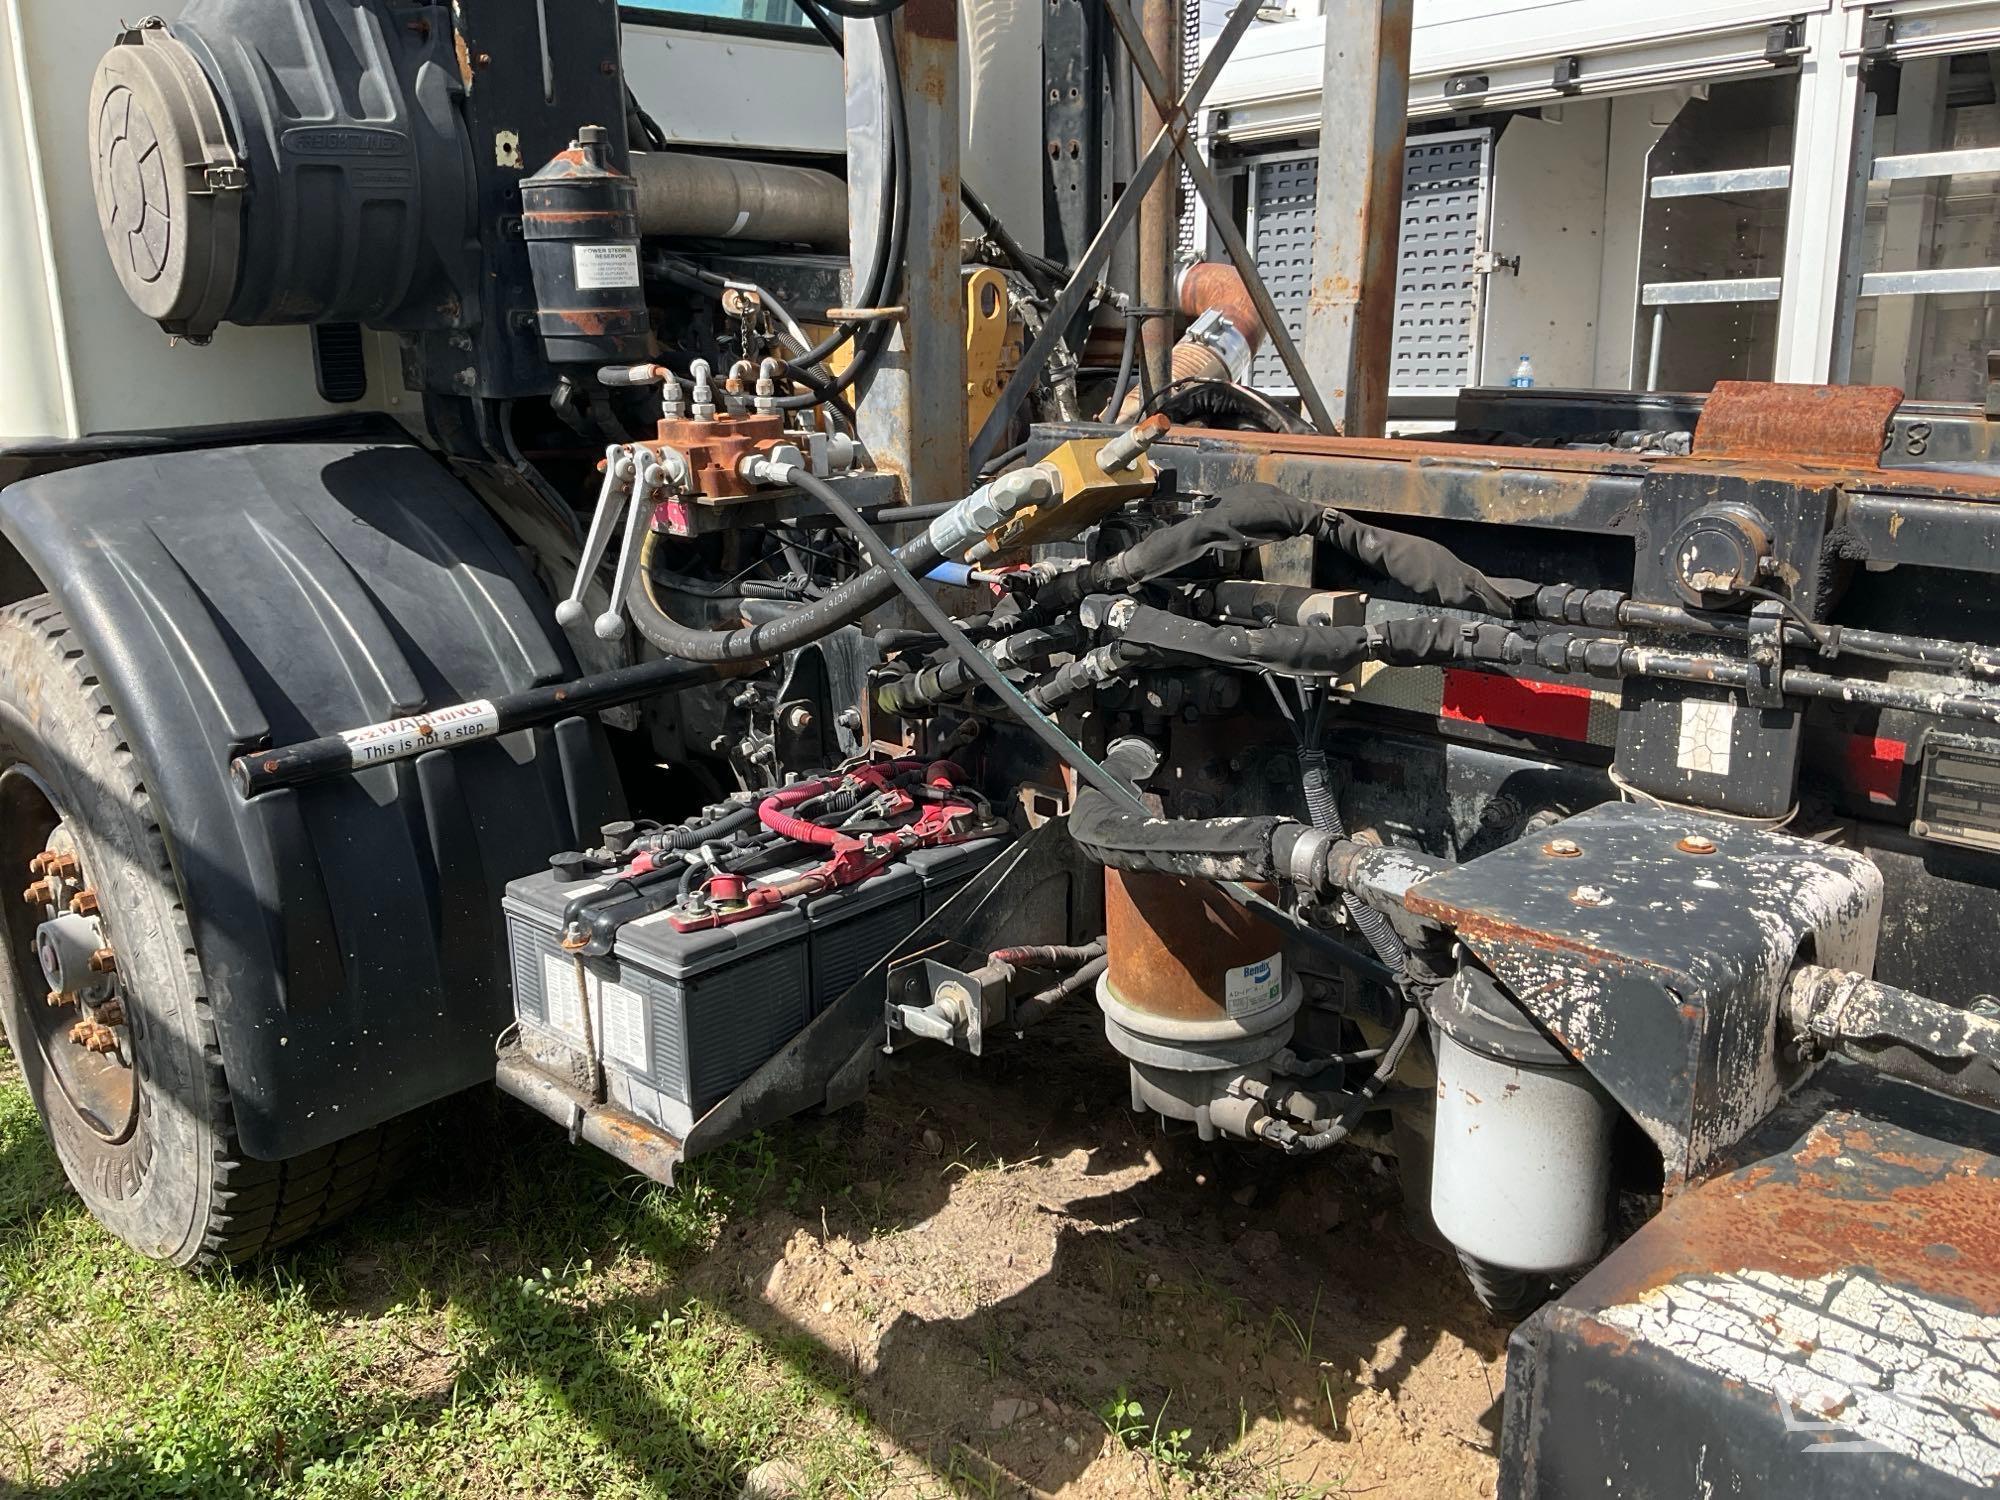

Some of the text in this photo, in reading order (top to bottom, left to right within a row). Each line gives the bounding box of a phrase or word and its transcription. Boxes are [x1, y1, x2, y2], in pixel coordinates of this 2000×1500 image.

[379, 705, 481, 735] WARNING
[363, 722, 488, 760] This is not a step.
[1243, 960, 1270, 977] Bendix
